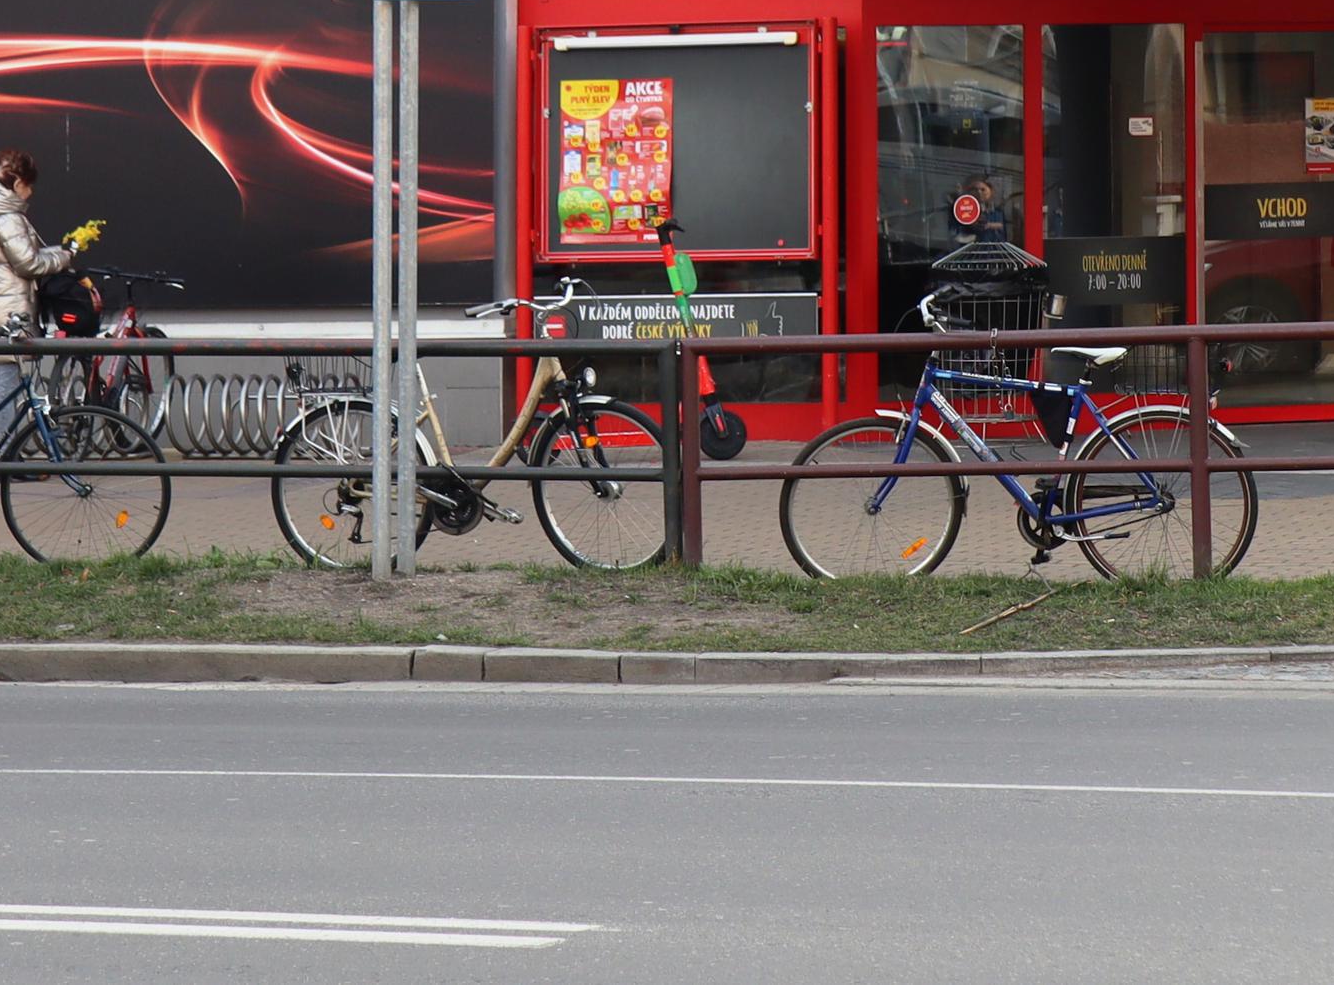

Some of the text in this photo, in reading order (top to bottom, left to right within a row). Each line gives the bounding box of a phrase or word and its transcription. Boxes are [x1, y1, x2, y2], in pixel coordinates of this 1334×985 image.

[625, 81, 663, 95] AKCE
[1257, 198, 1307, 218] VCHOD
[1083, 250, 1147, 272] OTEVŘENO DENNĚ
[1088, 274, 1107, 291] 7:00
[1117, 273, 1142, 290] 20:00
[578, 303, 735, 321] V KAŽDÉM ODDĚLEN NAJDETE
[602, 323, 633, 339] DOBRÉ
[636, 323, 664, 339] ČESKÉ
